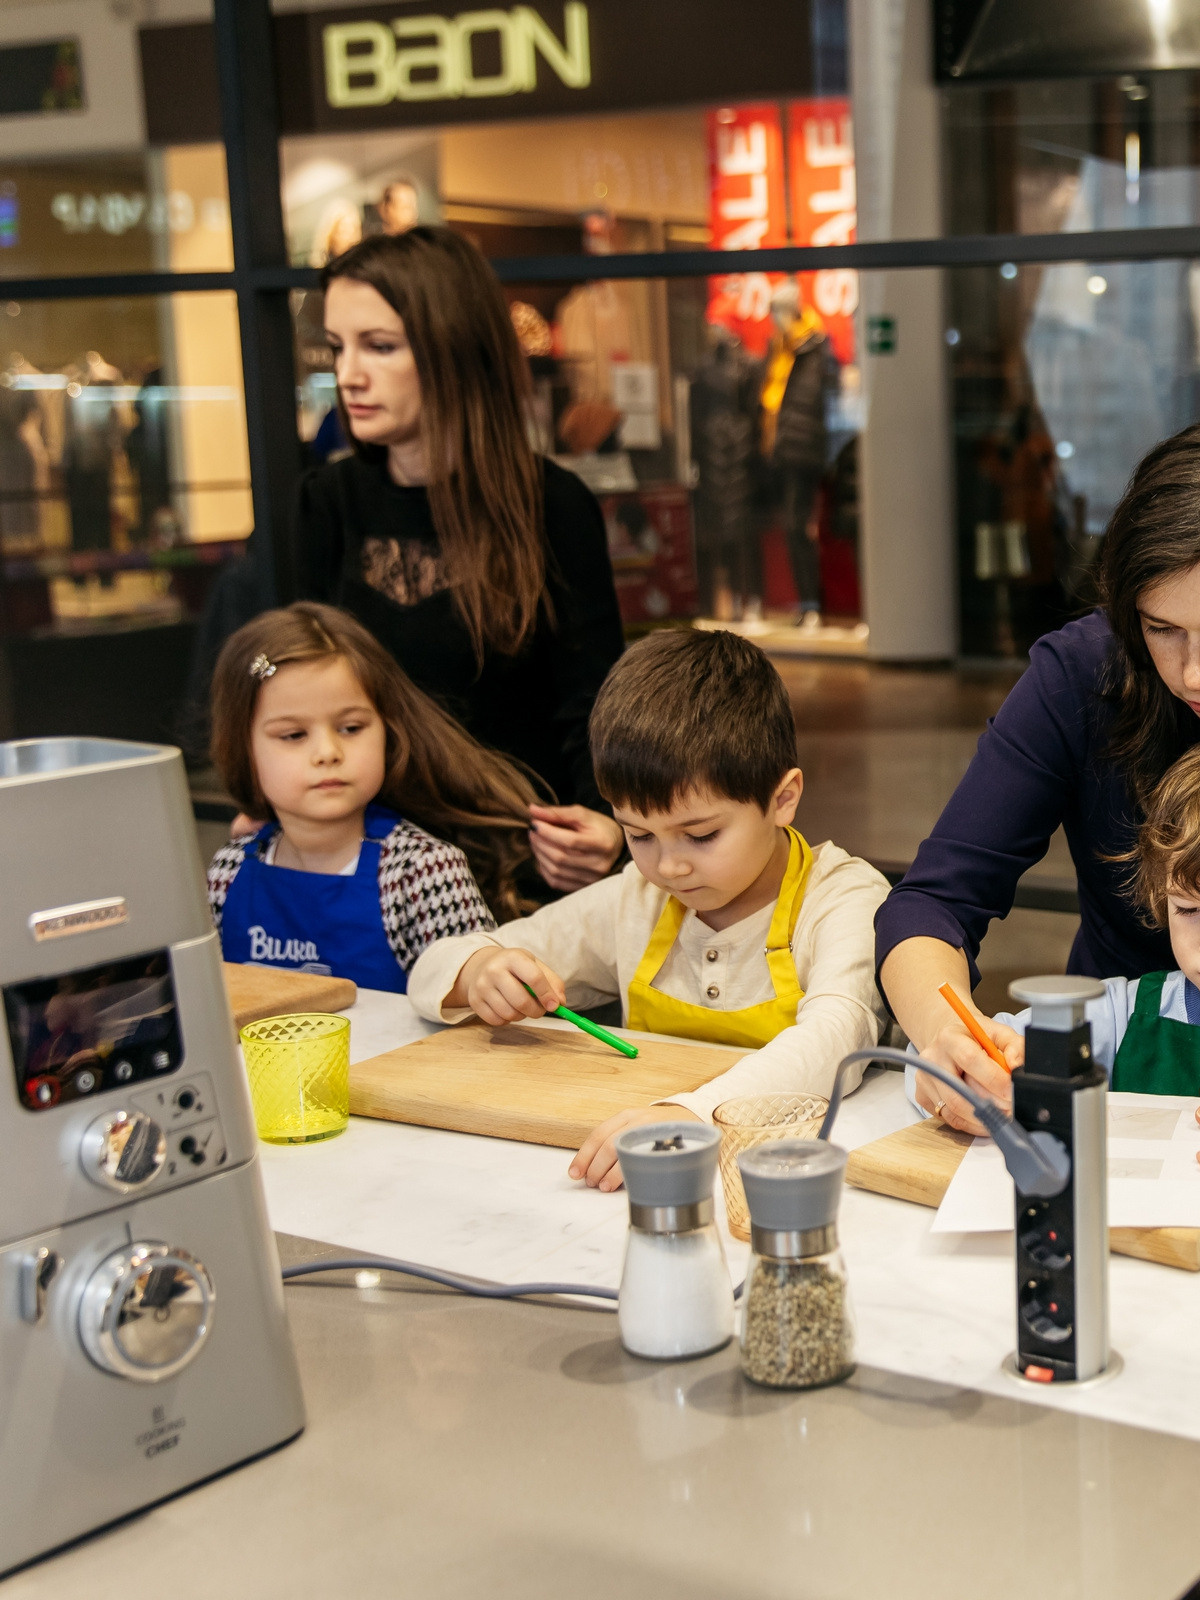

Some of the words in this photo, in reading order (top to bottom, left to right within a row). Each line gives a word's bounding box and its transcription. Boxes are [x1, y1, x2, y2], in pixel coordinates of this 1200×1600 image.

[716, 120, 771, 322] SALE
[804, 113, 859, 318] SALE
[247, 925, 320, 962] Вилка
